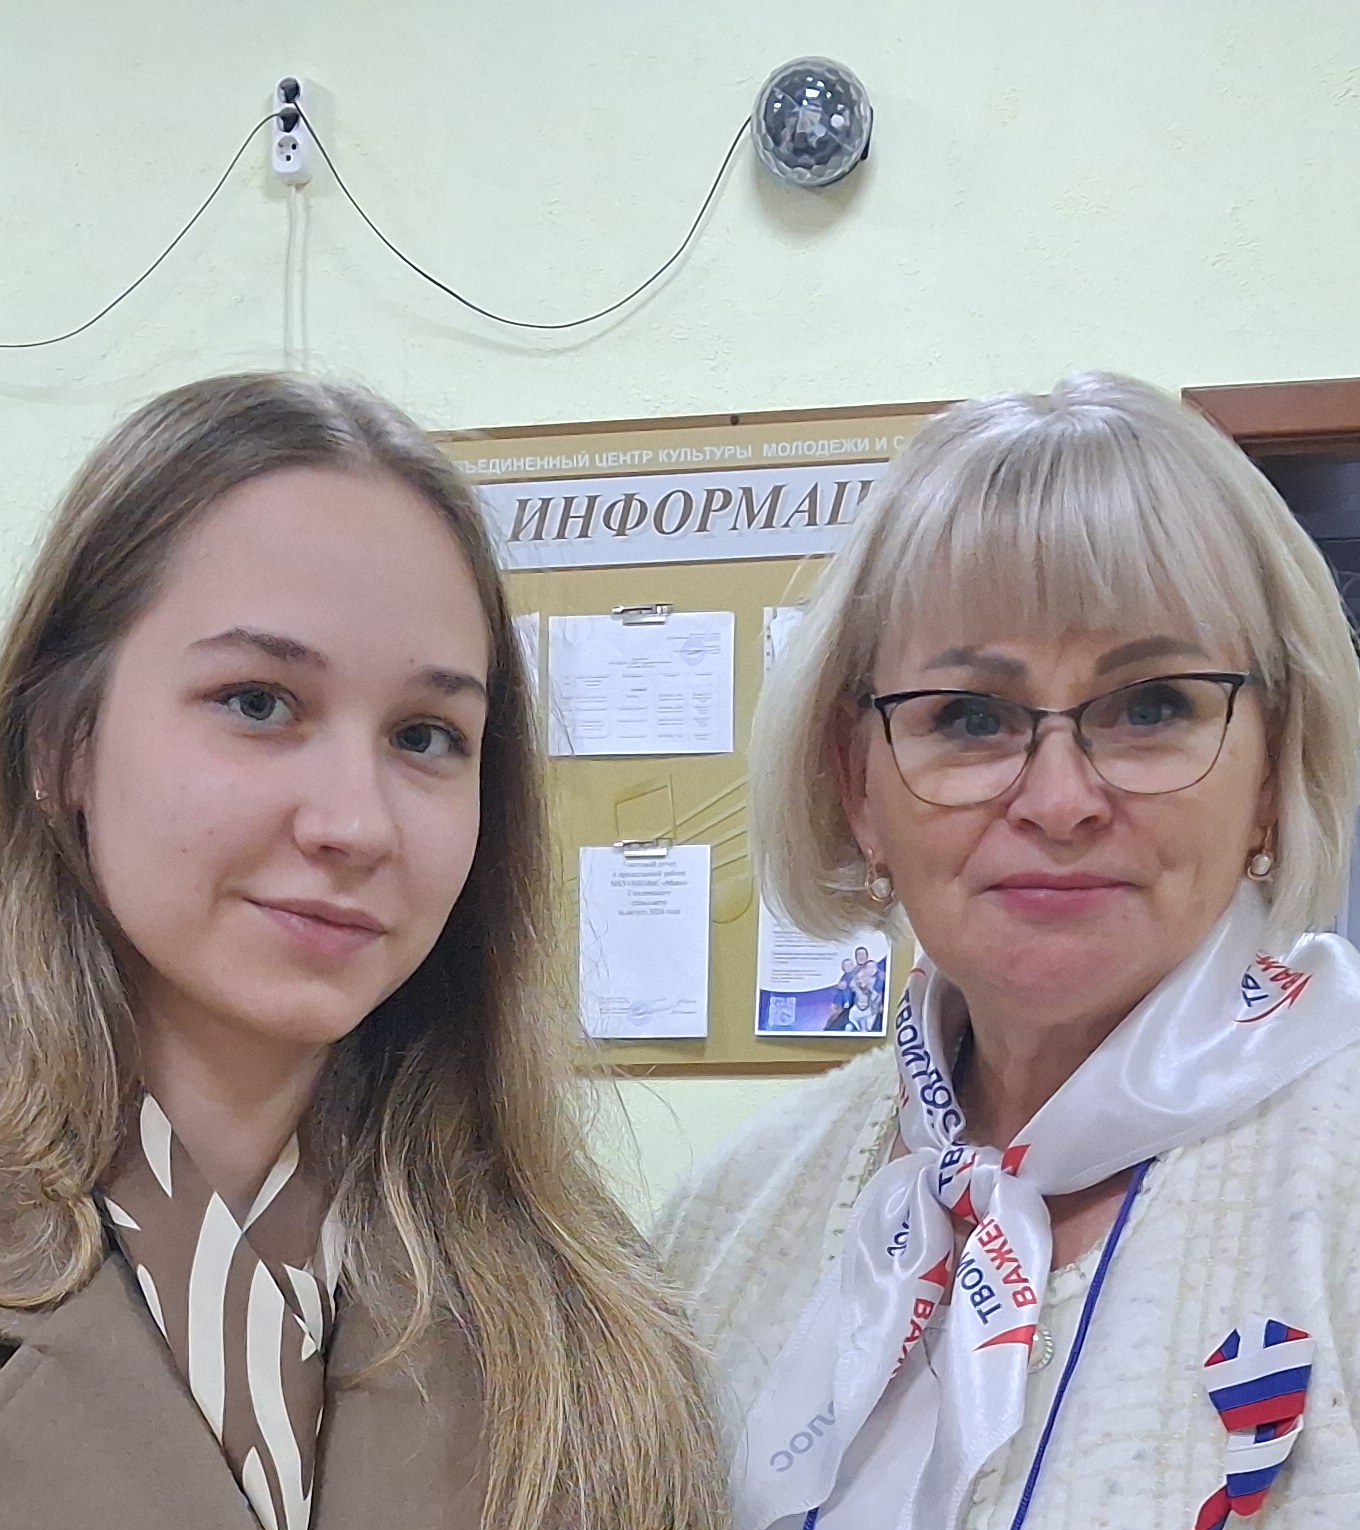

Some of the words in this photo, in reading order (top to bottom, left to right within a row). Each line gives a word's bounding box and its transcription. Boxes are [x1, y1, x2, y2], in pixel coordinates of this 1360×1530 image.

[595, 450, 653, 469] ЦЕНТР
[659, 445, 752, 463] КУЛЬТУРЫ
[763, 438, 870, 457] МОЛОДЕЖИ
[875, 437, 887, 450] И
